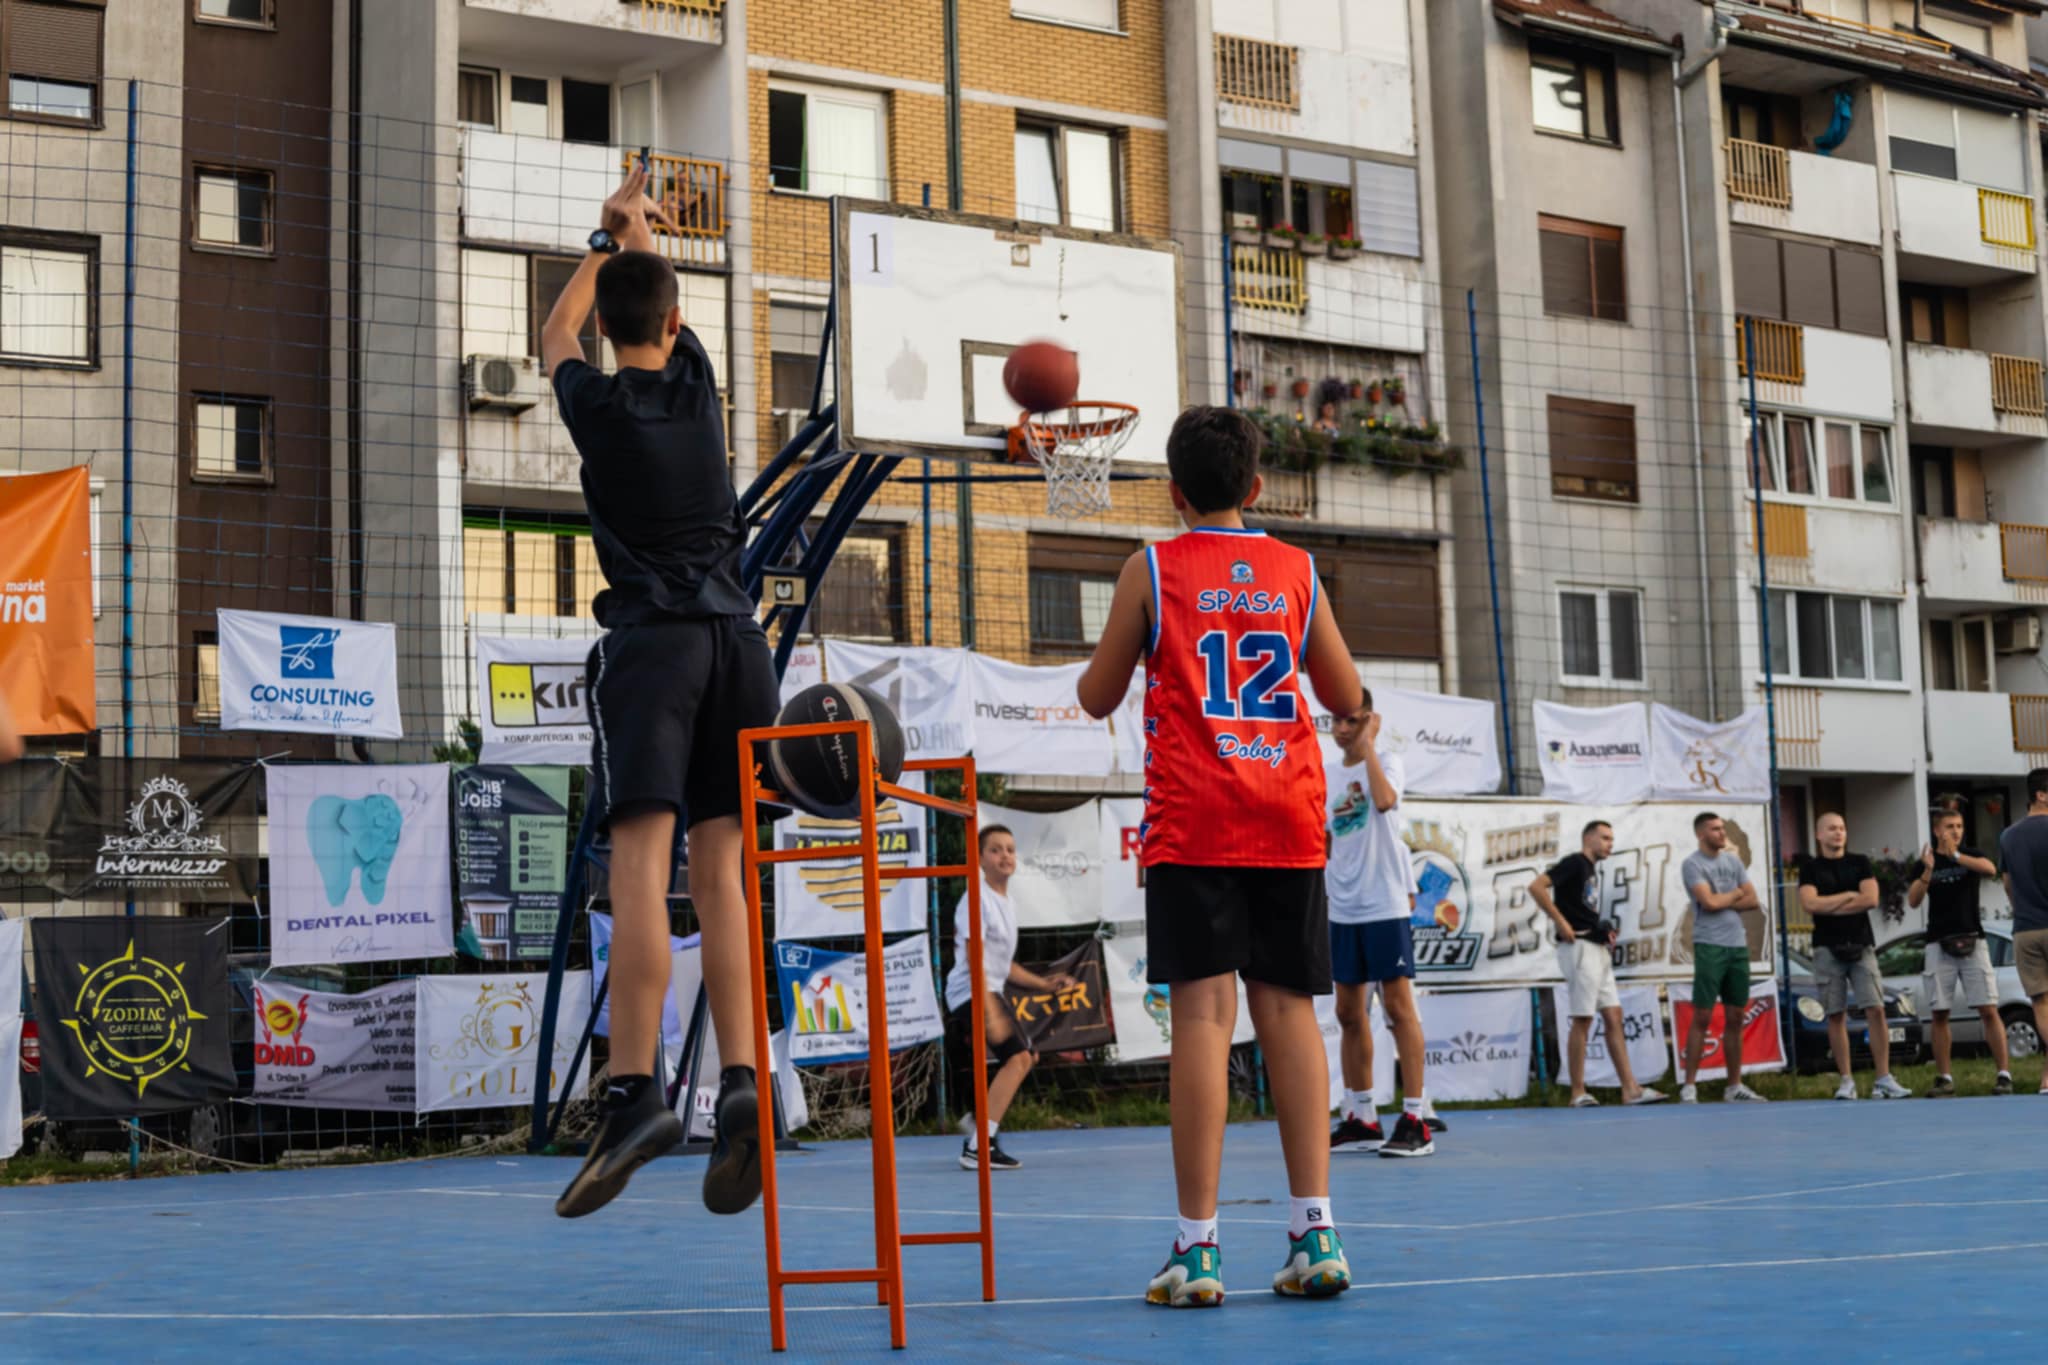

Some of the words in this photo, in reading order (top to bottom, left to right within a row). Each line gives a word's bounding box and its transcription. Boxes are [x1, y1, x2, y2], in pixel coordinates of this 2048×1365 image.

[868, 232, 881, 274] 1
[5, 580, 45, 593] market
[0, 594, 46, 623] na
[1197, 589, 1287, 614] SPASA
[1197, 630, 1297, 722] 12
[250, 683, 375, 707] CONSULTING
[1215, 733, 1287, 767] Doboj
[459, 793, 502, 808] JOBS
[96, 855, 227, 874] Intermezzo
[127, 880, 167, 888] PIZZERIA
[1487, 842, 1671, 961] RFI
[287, 915, 372, 932] DENTAL
[375, 911, 435, 926] PIXEL
[1414, 938, 1476, 966] UFI
[1611, 933, 1668, 967] OBOJ
[893, 957, 924, 970] PLUS
[102, 1007, 166, 1023] ZODIAC
[109, 1024, 140, 1034] CAFFE
[142, 1023, 163, 1033] BAR
[254, 1043, 316, 1067] DMD
[450, 1066, 557, 1098] GOL
